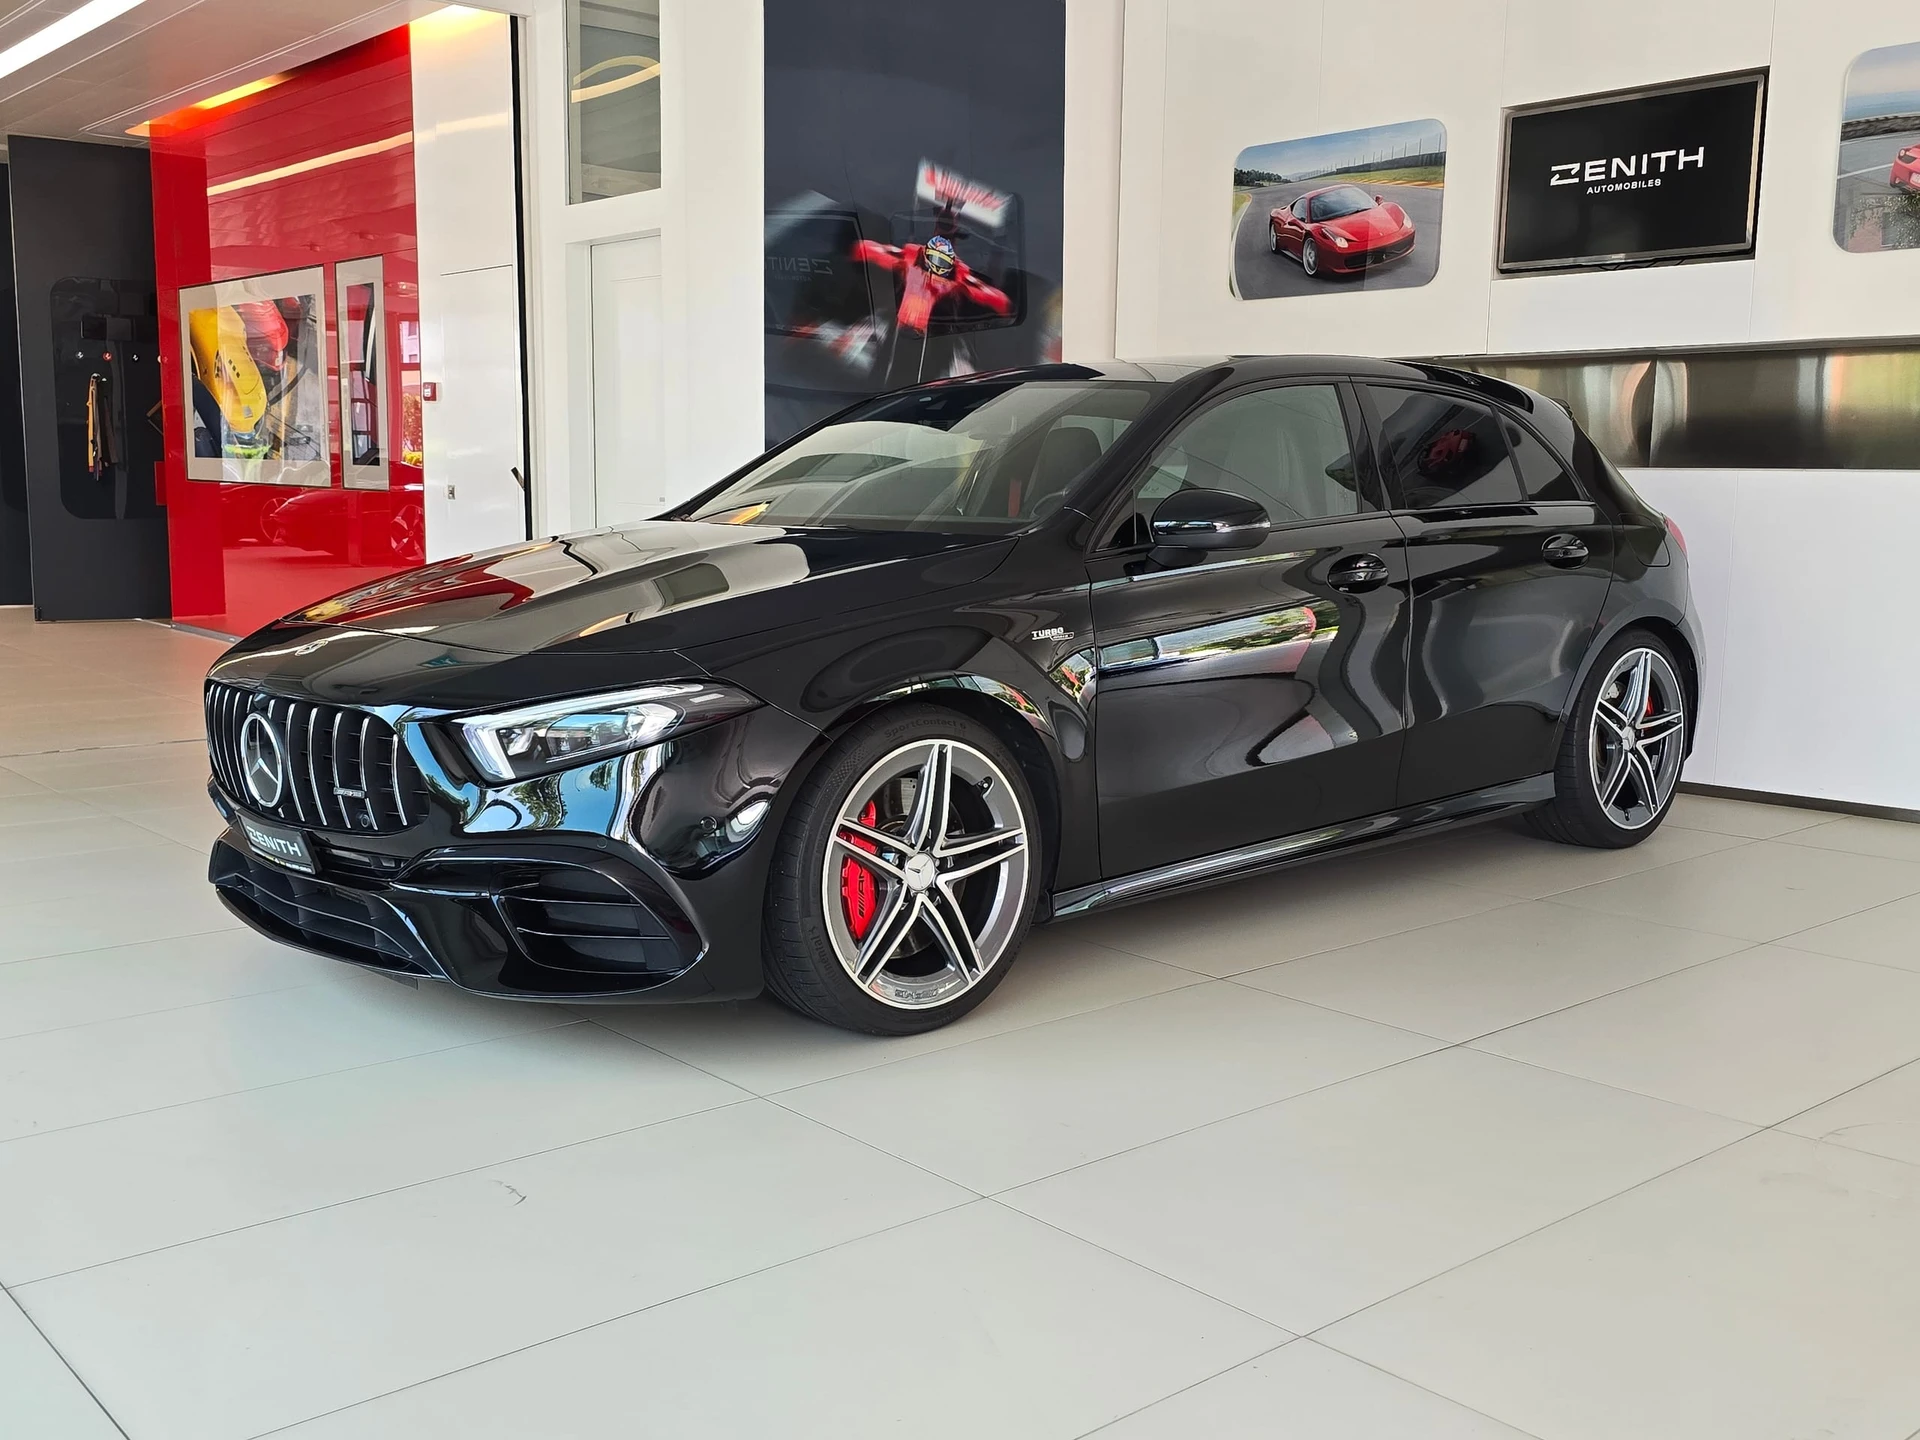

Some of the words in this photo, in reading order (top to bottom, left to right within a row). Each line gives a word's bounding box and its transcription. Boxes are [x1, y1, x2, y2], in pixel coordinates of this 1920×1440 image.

[1550, 146, 1705, 186] ZENITH
[1586, 179, 1662, 194] AUTOMOBILES
[1031, 628, 1063, 638] TURBO
[247, 826, 302, 857] ZENITH
